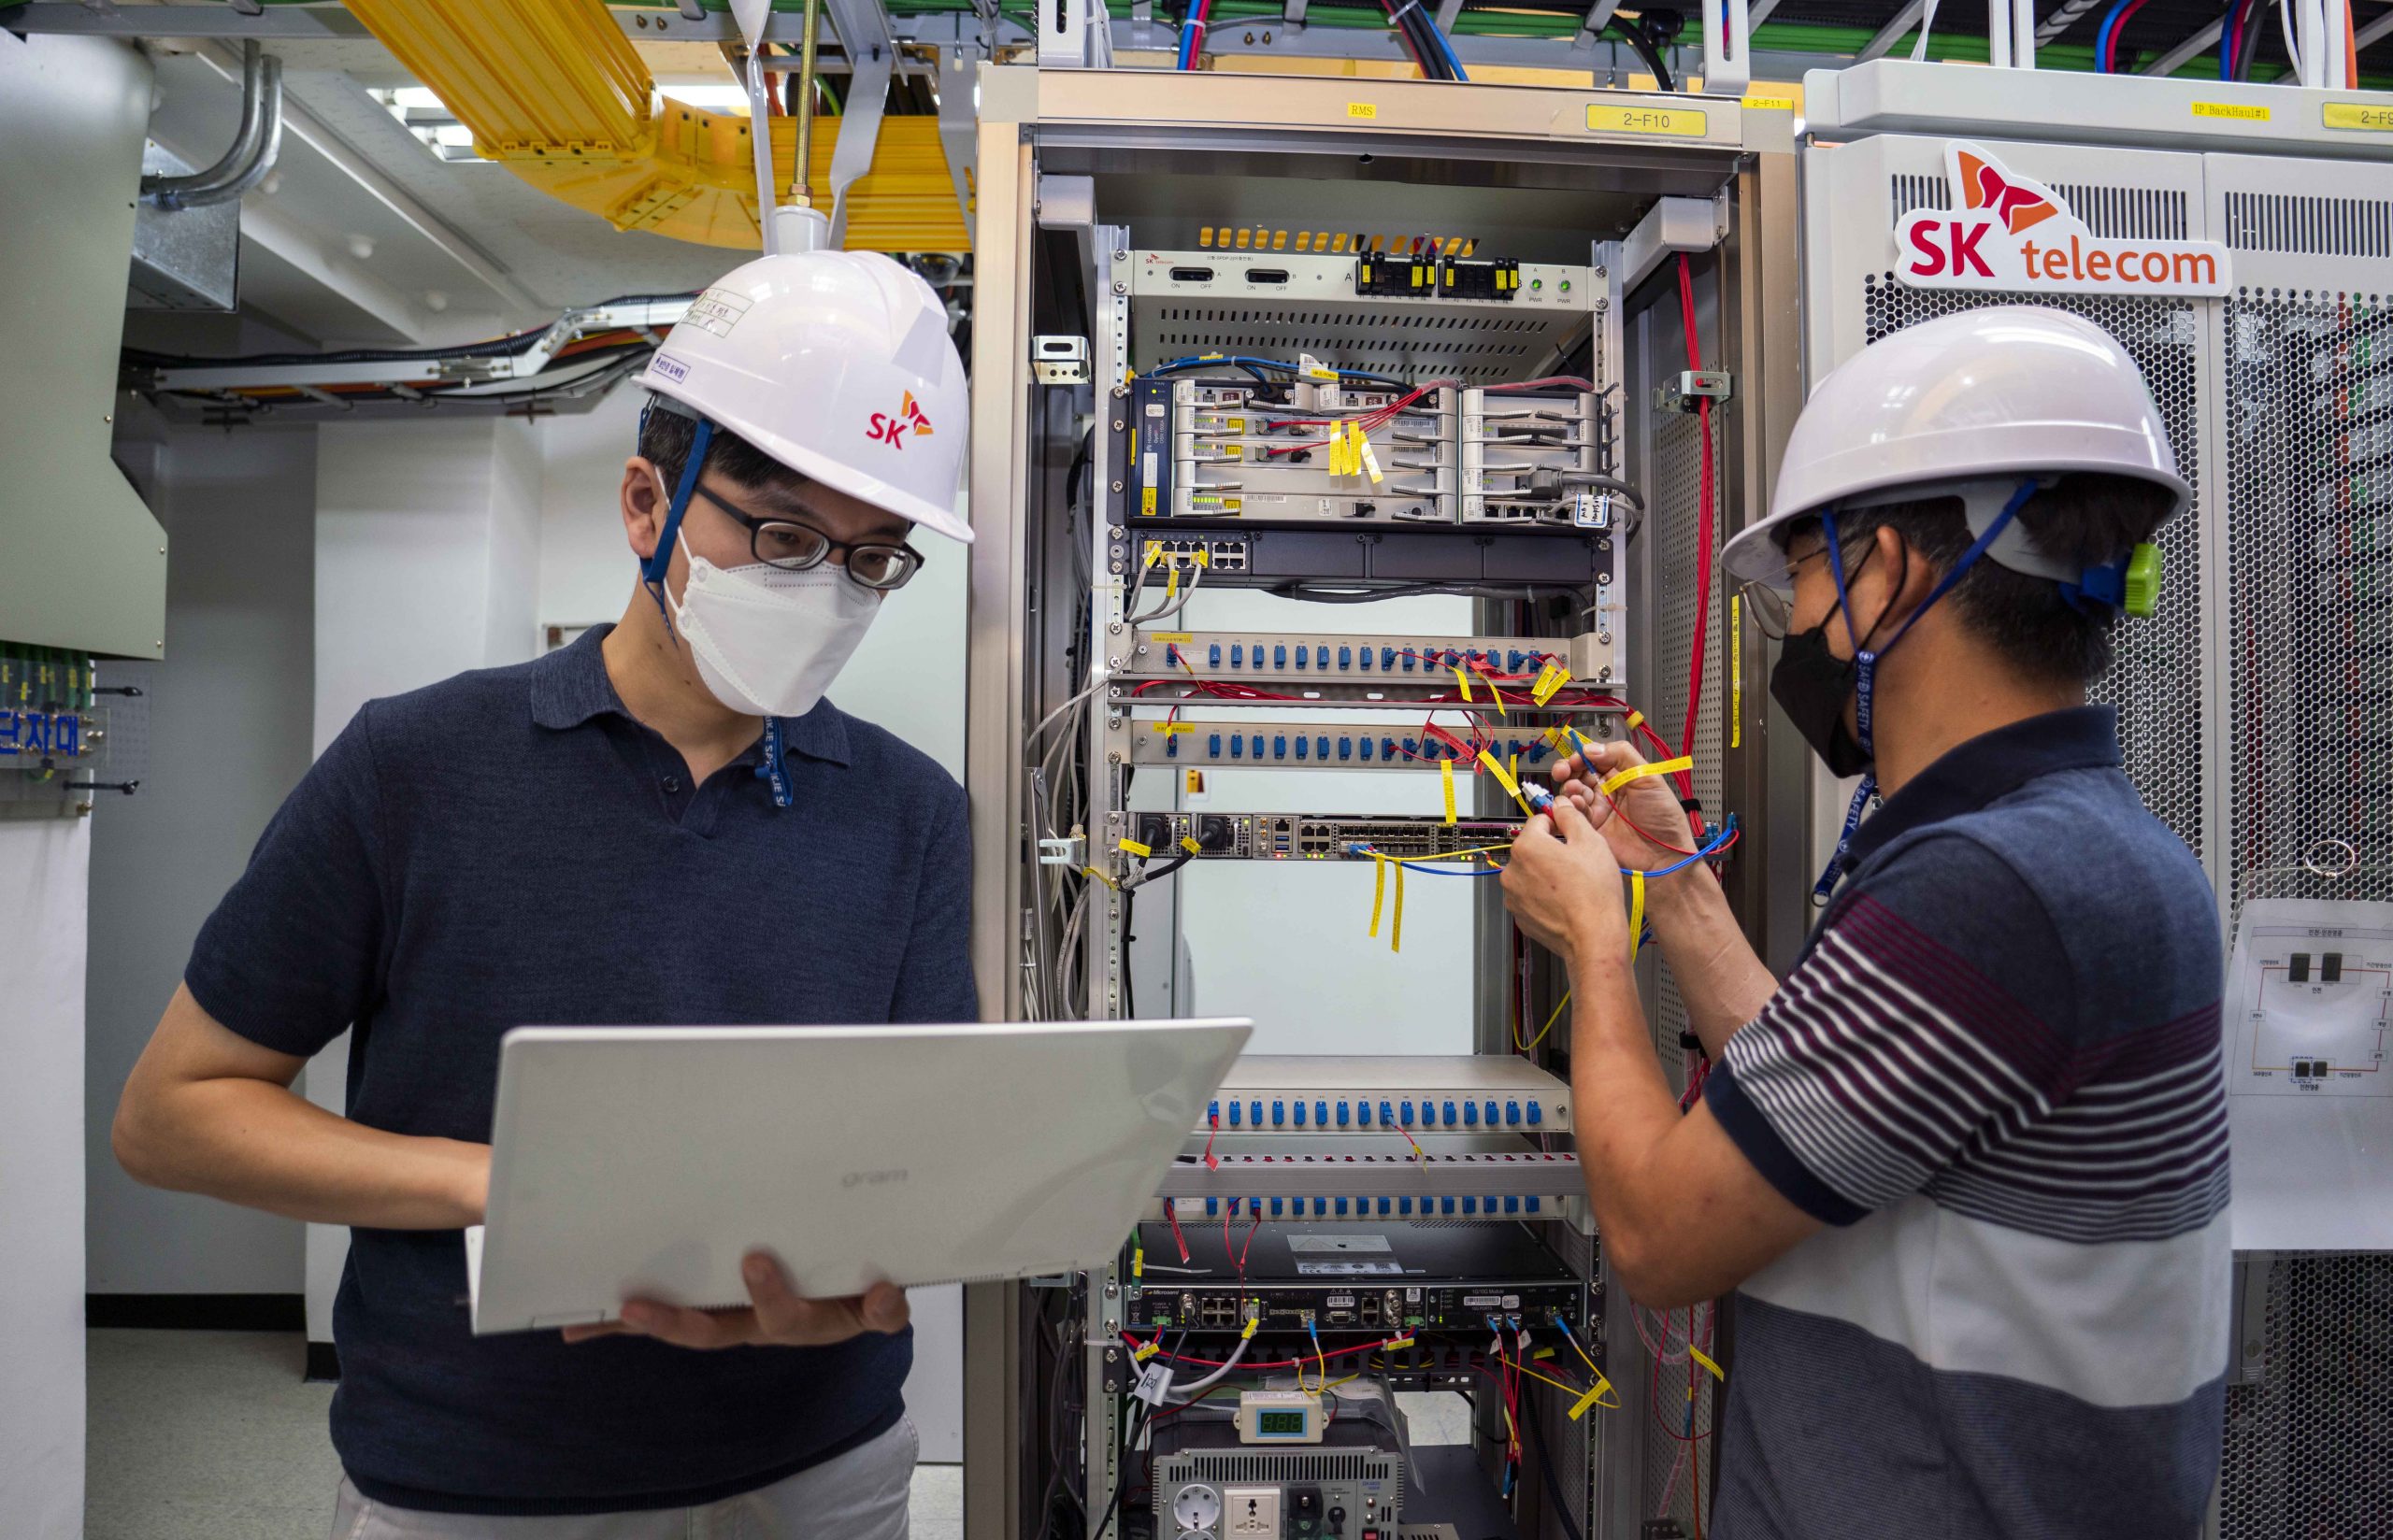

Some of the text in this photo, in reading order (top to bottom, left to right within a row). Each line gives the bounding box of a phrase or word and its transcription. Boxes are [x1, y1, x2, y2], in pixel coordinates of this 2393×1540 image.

[1352, 105, 1372, 116] RMS
[1753, 99, 1781, 107] 2-F11
[2194, 104, 2267, 119] IP BackHaul#1
[1624, 112, 1670, 128] 2-F10
[1910, 220, 2216, 284] SK telecom
[1344, 273, 1353, 281] A
[866, 413, 908, 450] SK
[1856, 693, 1870, 732] SAFETY
[1846, 787, 1867, 831] SAFETY
[841, 1168, 910, 1188] gram
